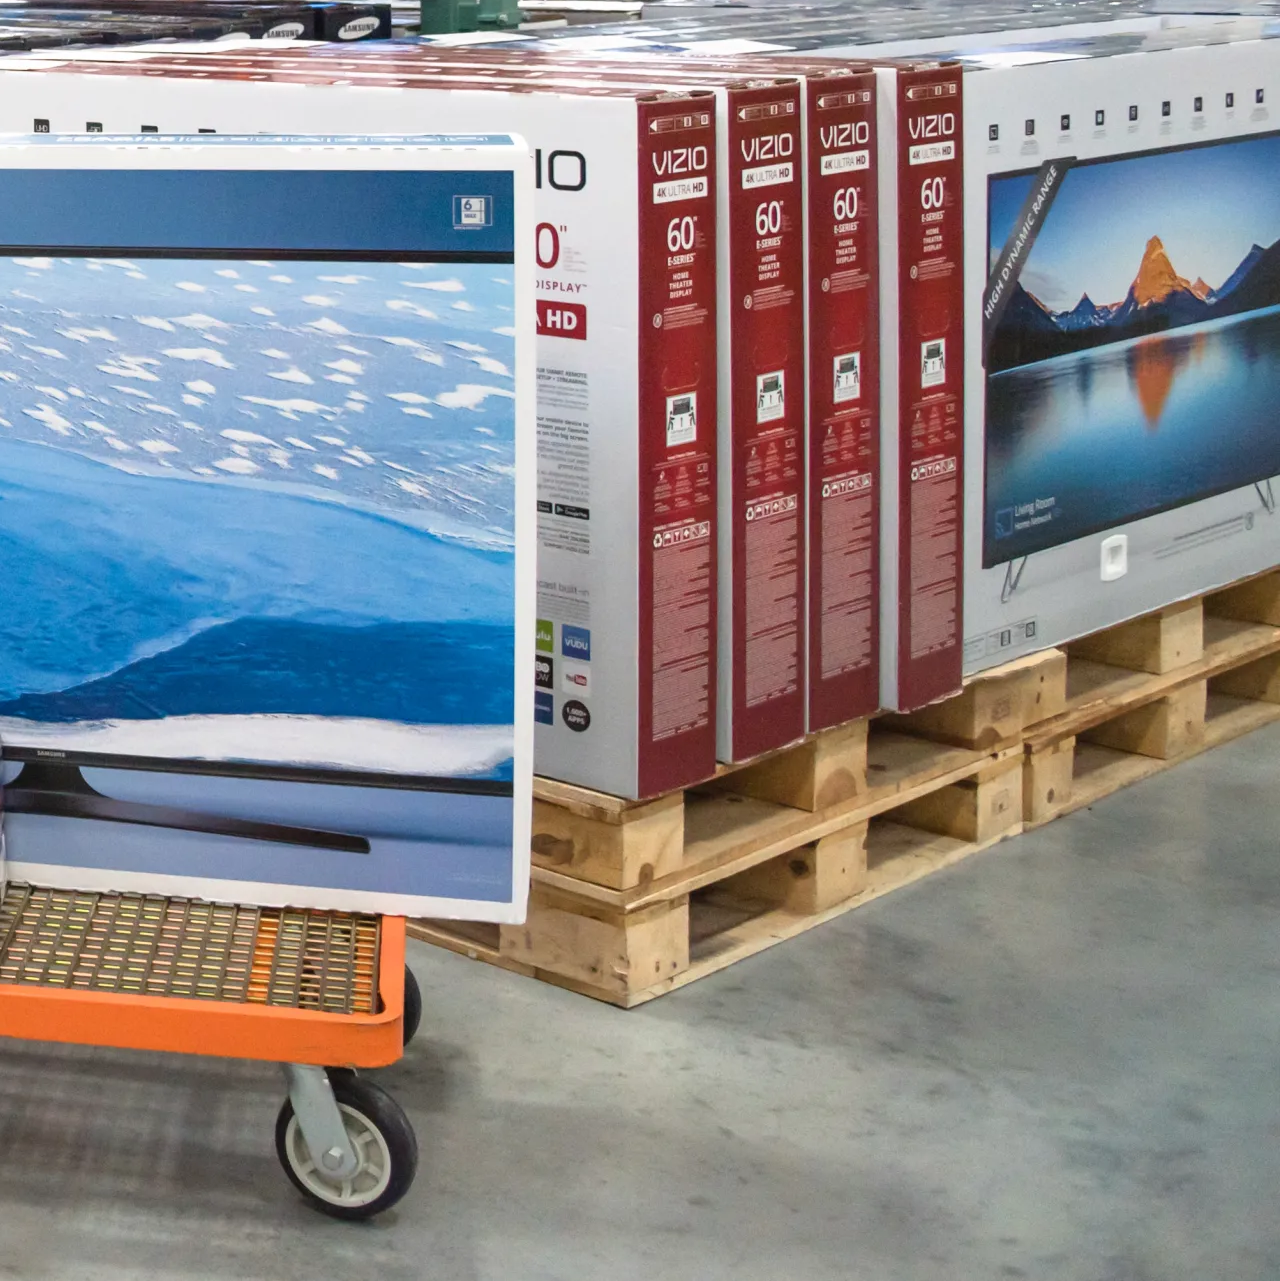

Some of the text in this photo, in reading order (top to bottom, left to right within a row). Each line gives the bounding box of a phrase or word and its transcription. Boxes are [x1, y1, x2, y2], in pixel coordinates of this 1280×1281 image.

[820, 121, 869, 149] VIZIO
[908, 112, 955, 140] VIZIO
[653, 146, 708, 175] VIZIO
[741, 133, 793, 162] VIZIO
[779, 168, 790, 178] HD
[668, 182, 704, 197] ULTRA HD
[755, 201, 784, 236] 60"
[667, 216, 698, 252] 60"
[984, 165, 1059, 320] HIGH DYNAMIC RANGE
[546, 309, 578, 331] HD
